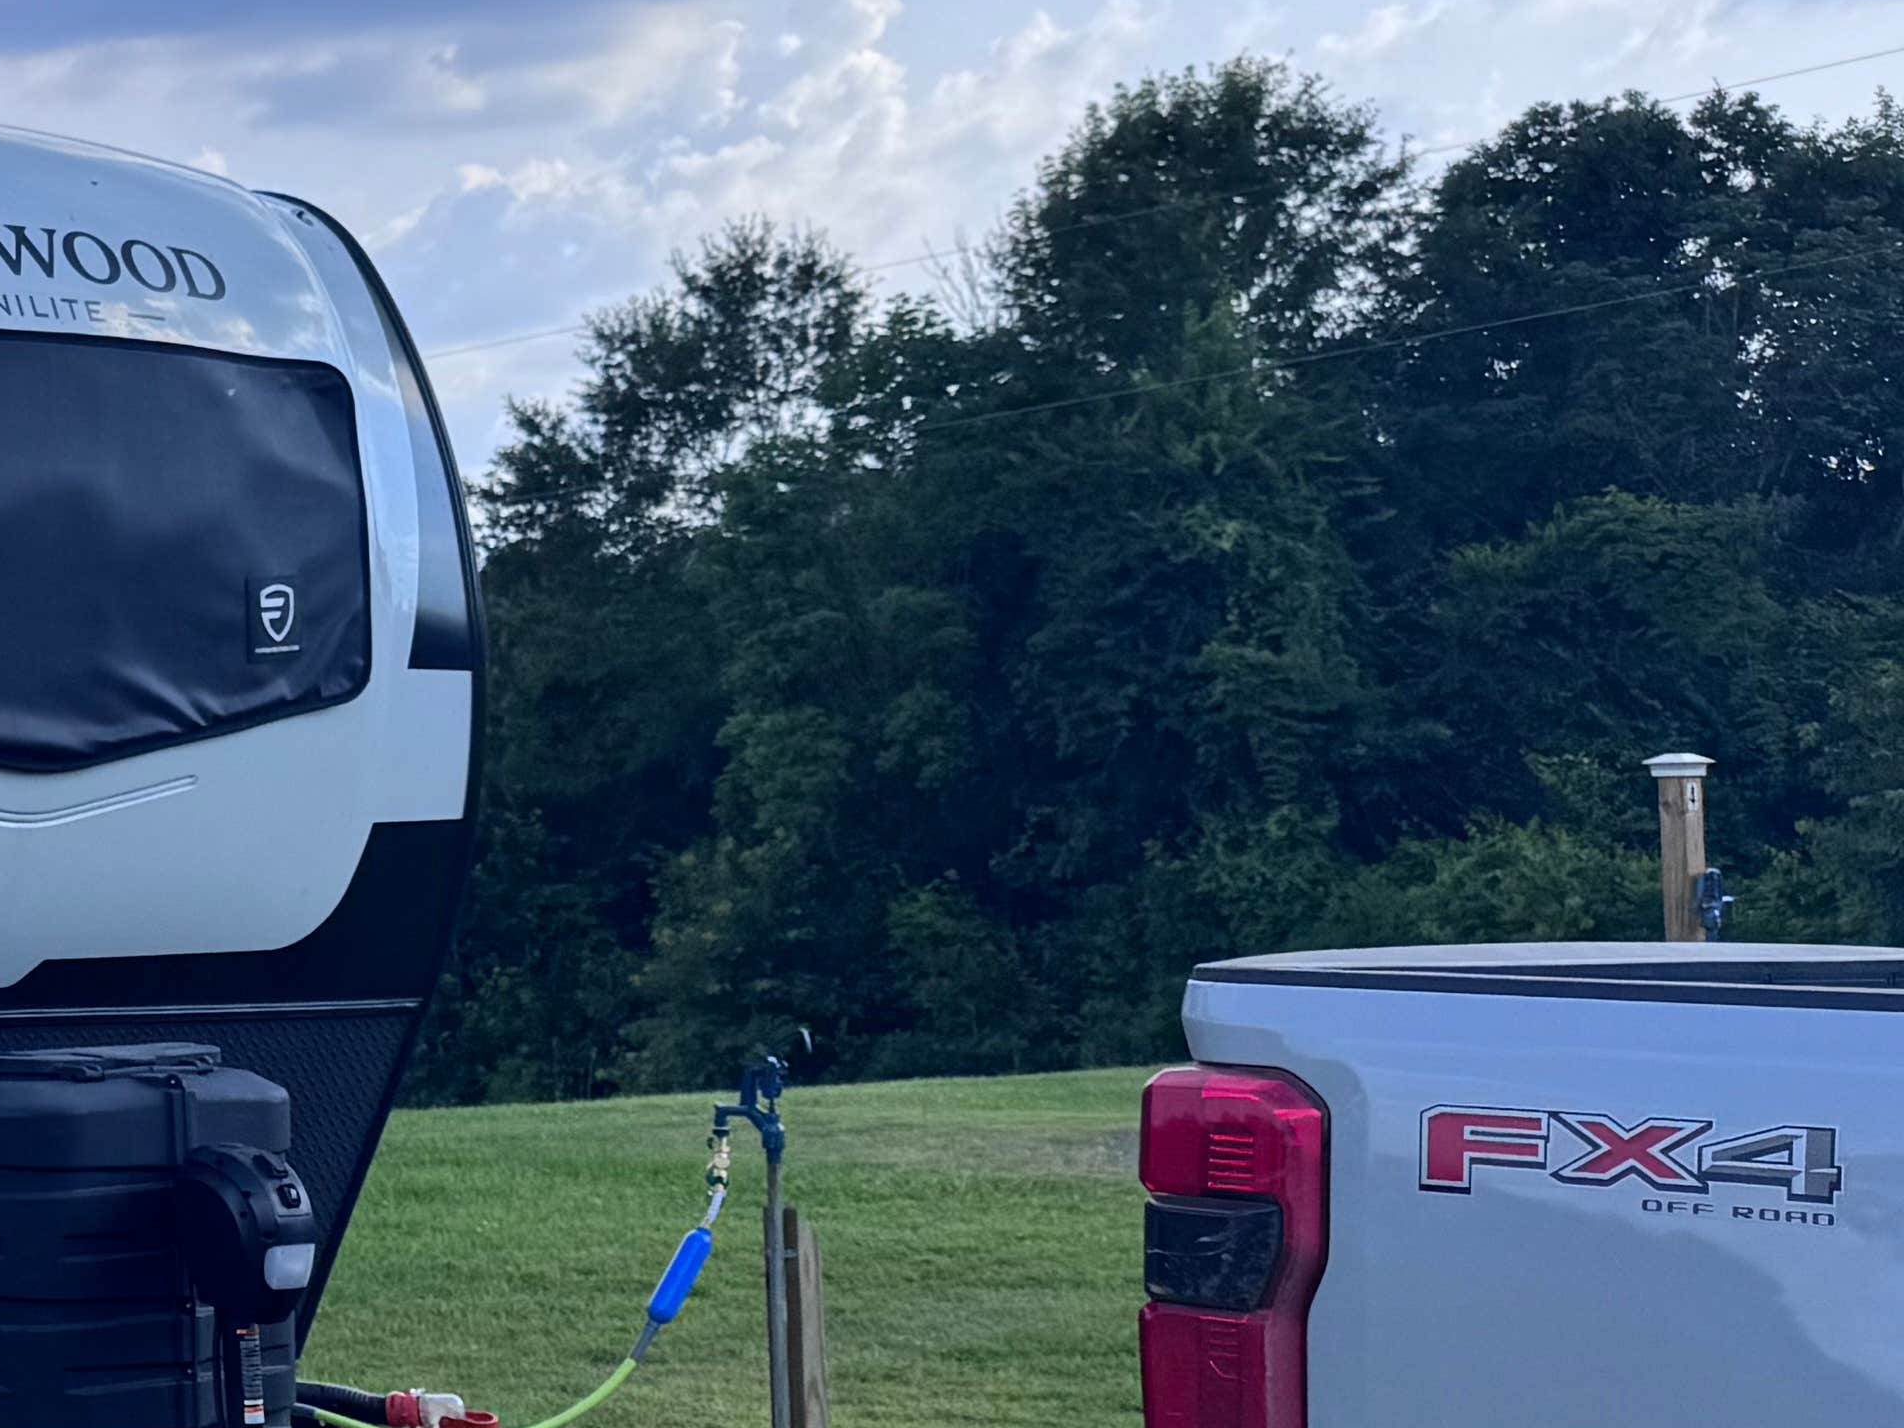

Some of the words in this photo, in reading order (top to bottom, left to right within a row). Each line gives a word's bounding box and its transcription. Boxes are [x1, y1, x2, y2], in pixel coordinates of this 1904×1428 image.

[1418, 1103, 1842, 1204] FX4
[1640, 1198, 1715, 1215] OFF
[1731, 1205, 1836, 1227] ROAD
